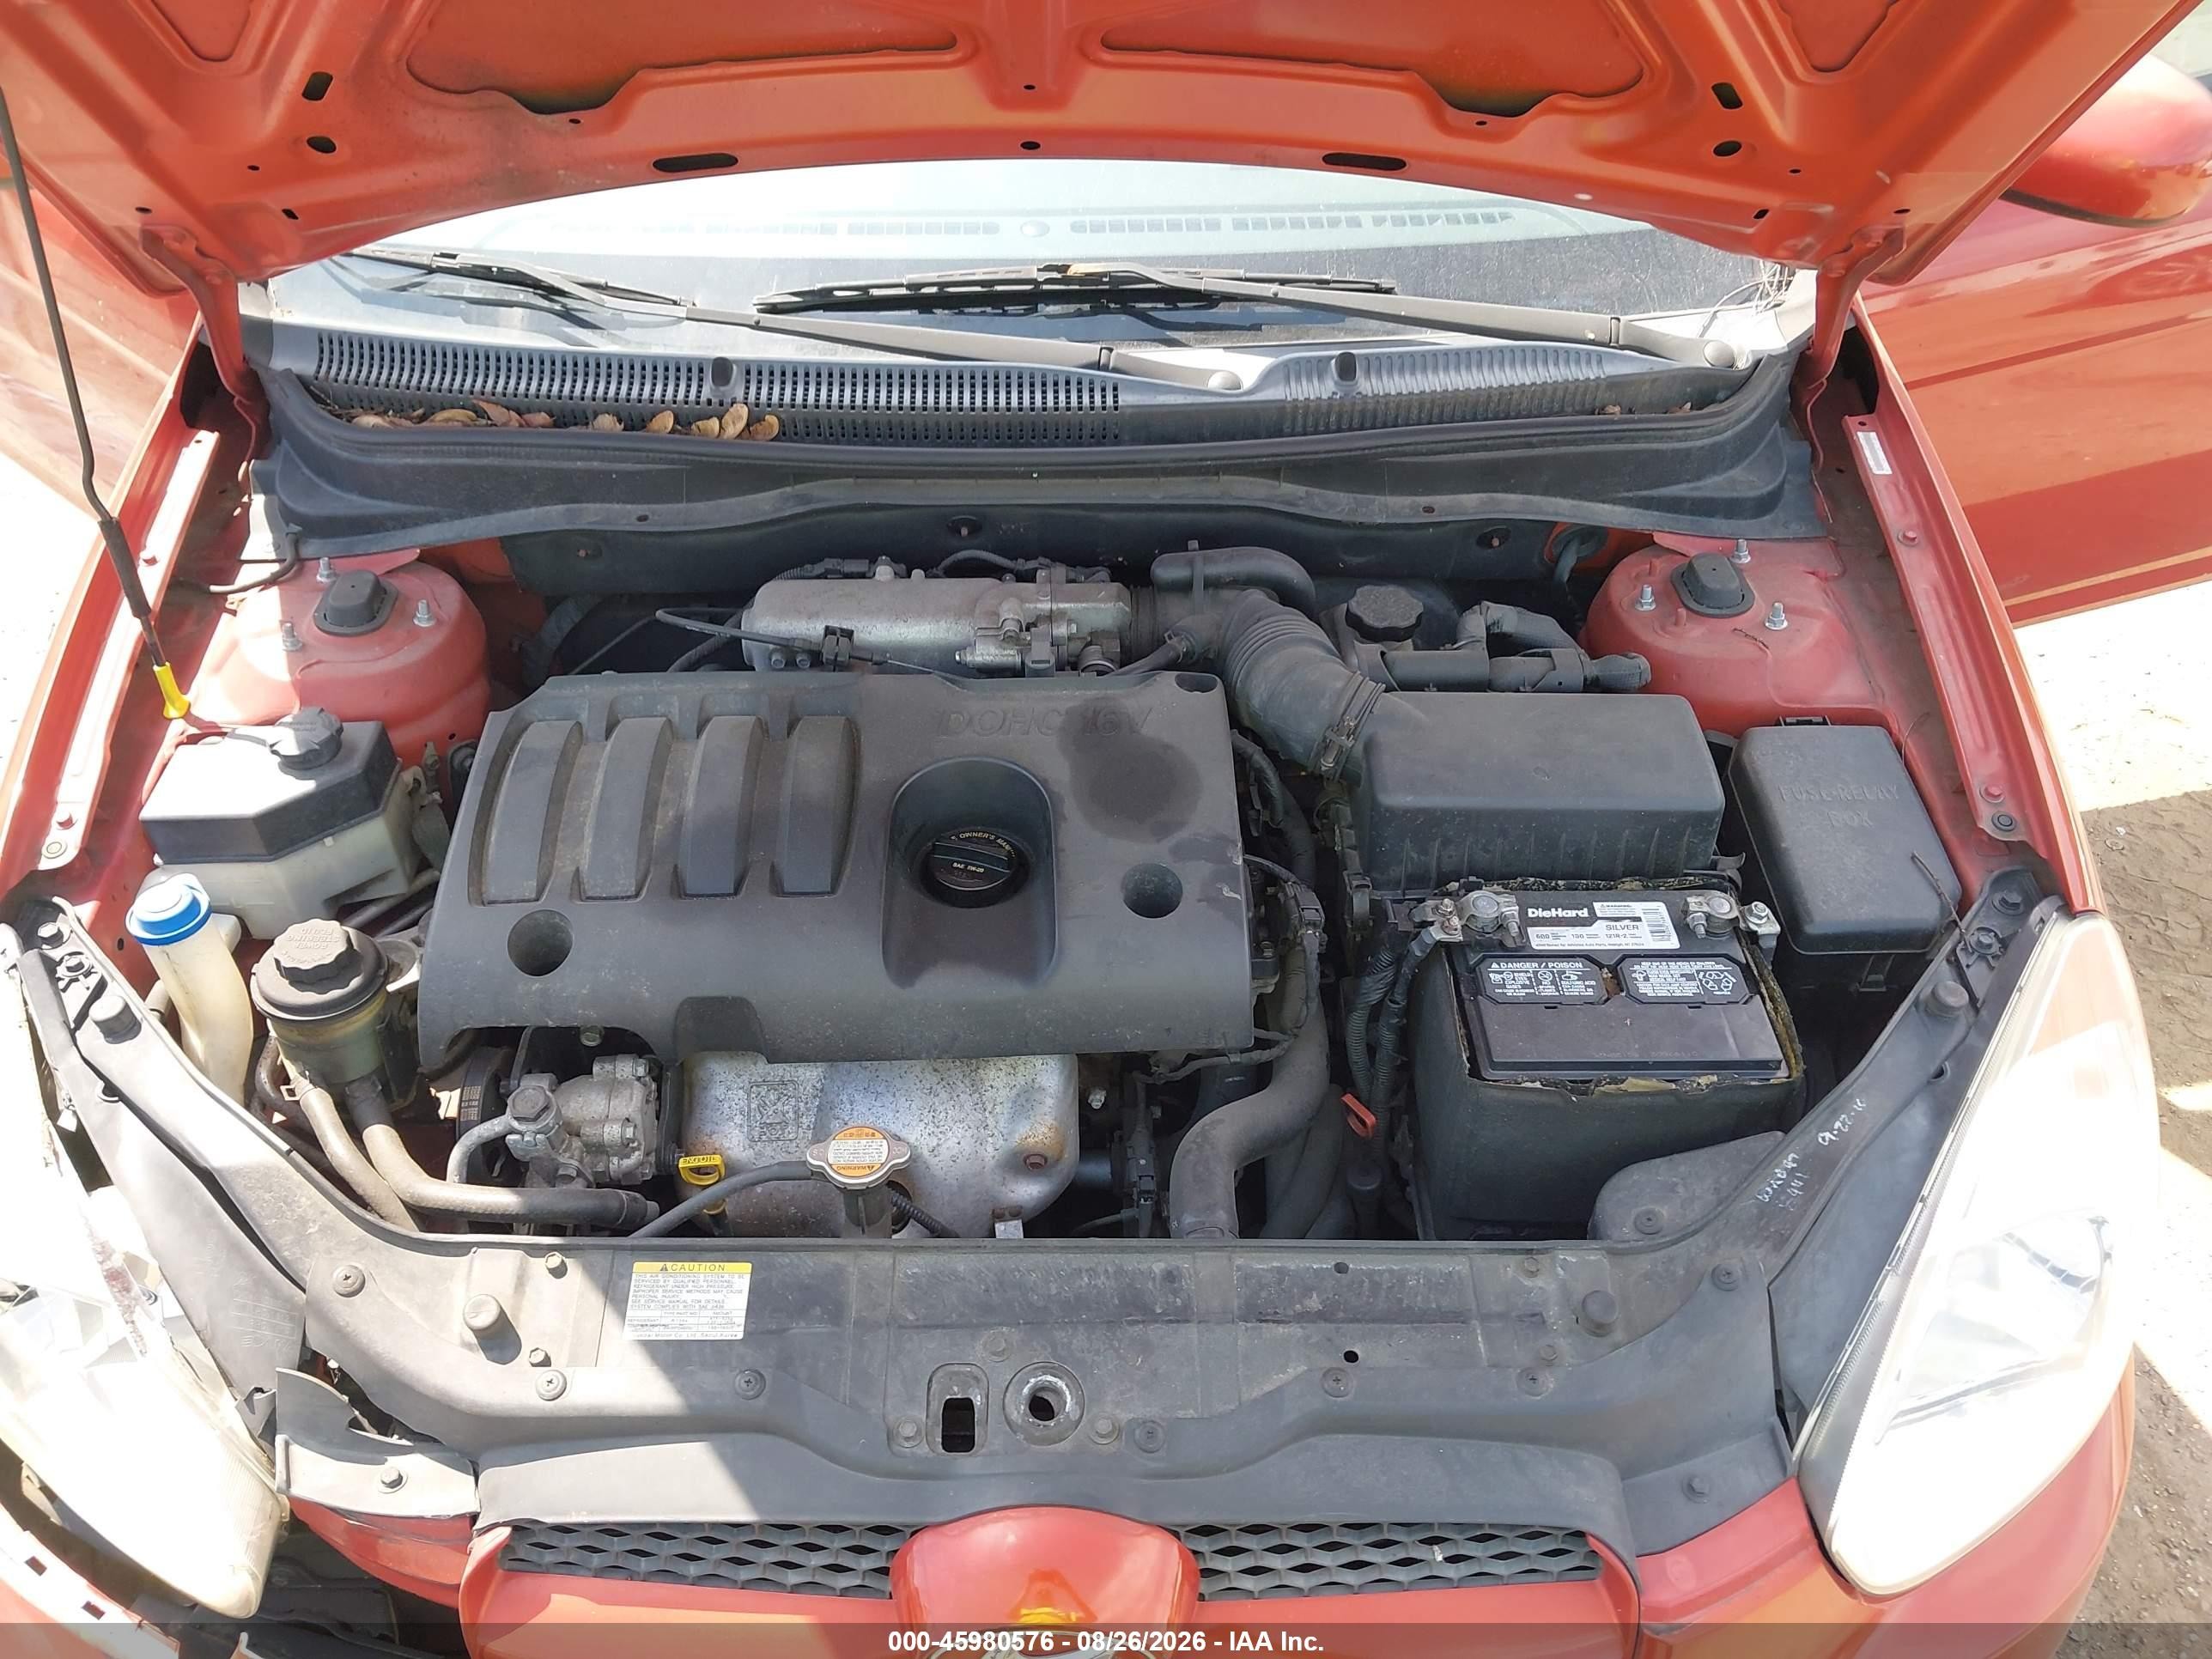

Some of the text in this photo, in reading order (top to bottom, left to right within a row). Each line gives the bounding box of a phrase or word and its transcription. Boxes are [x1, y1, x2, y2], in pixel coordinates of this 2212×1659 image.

[938, 708, 1152, 737] DOHC 16V
[959, 831, 996, 840] OWNER'S
[1528, 908, 1589, 917] DieHard
